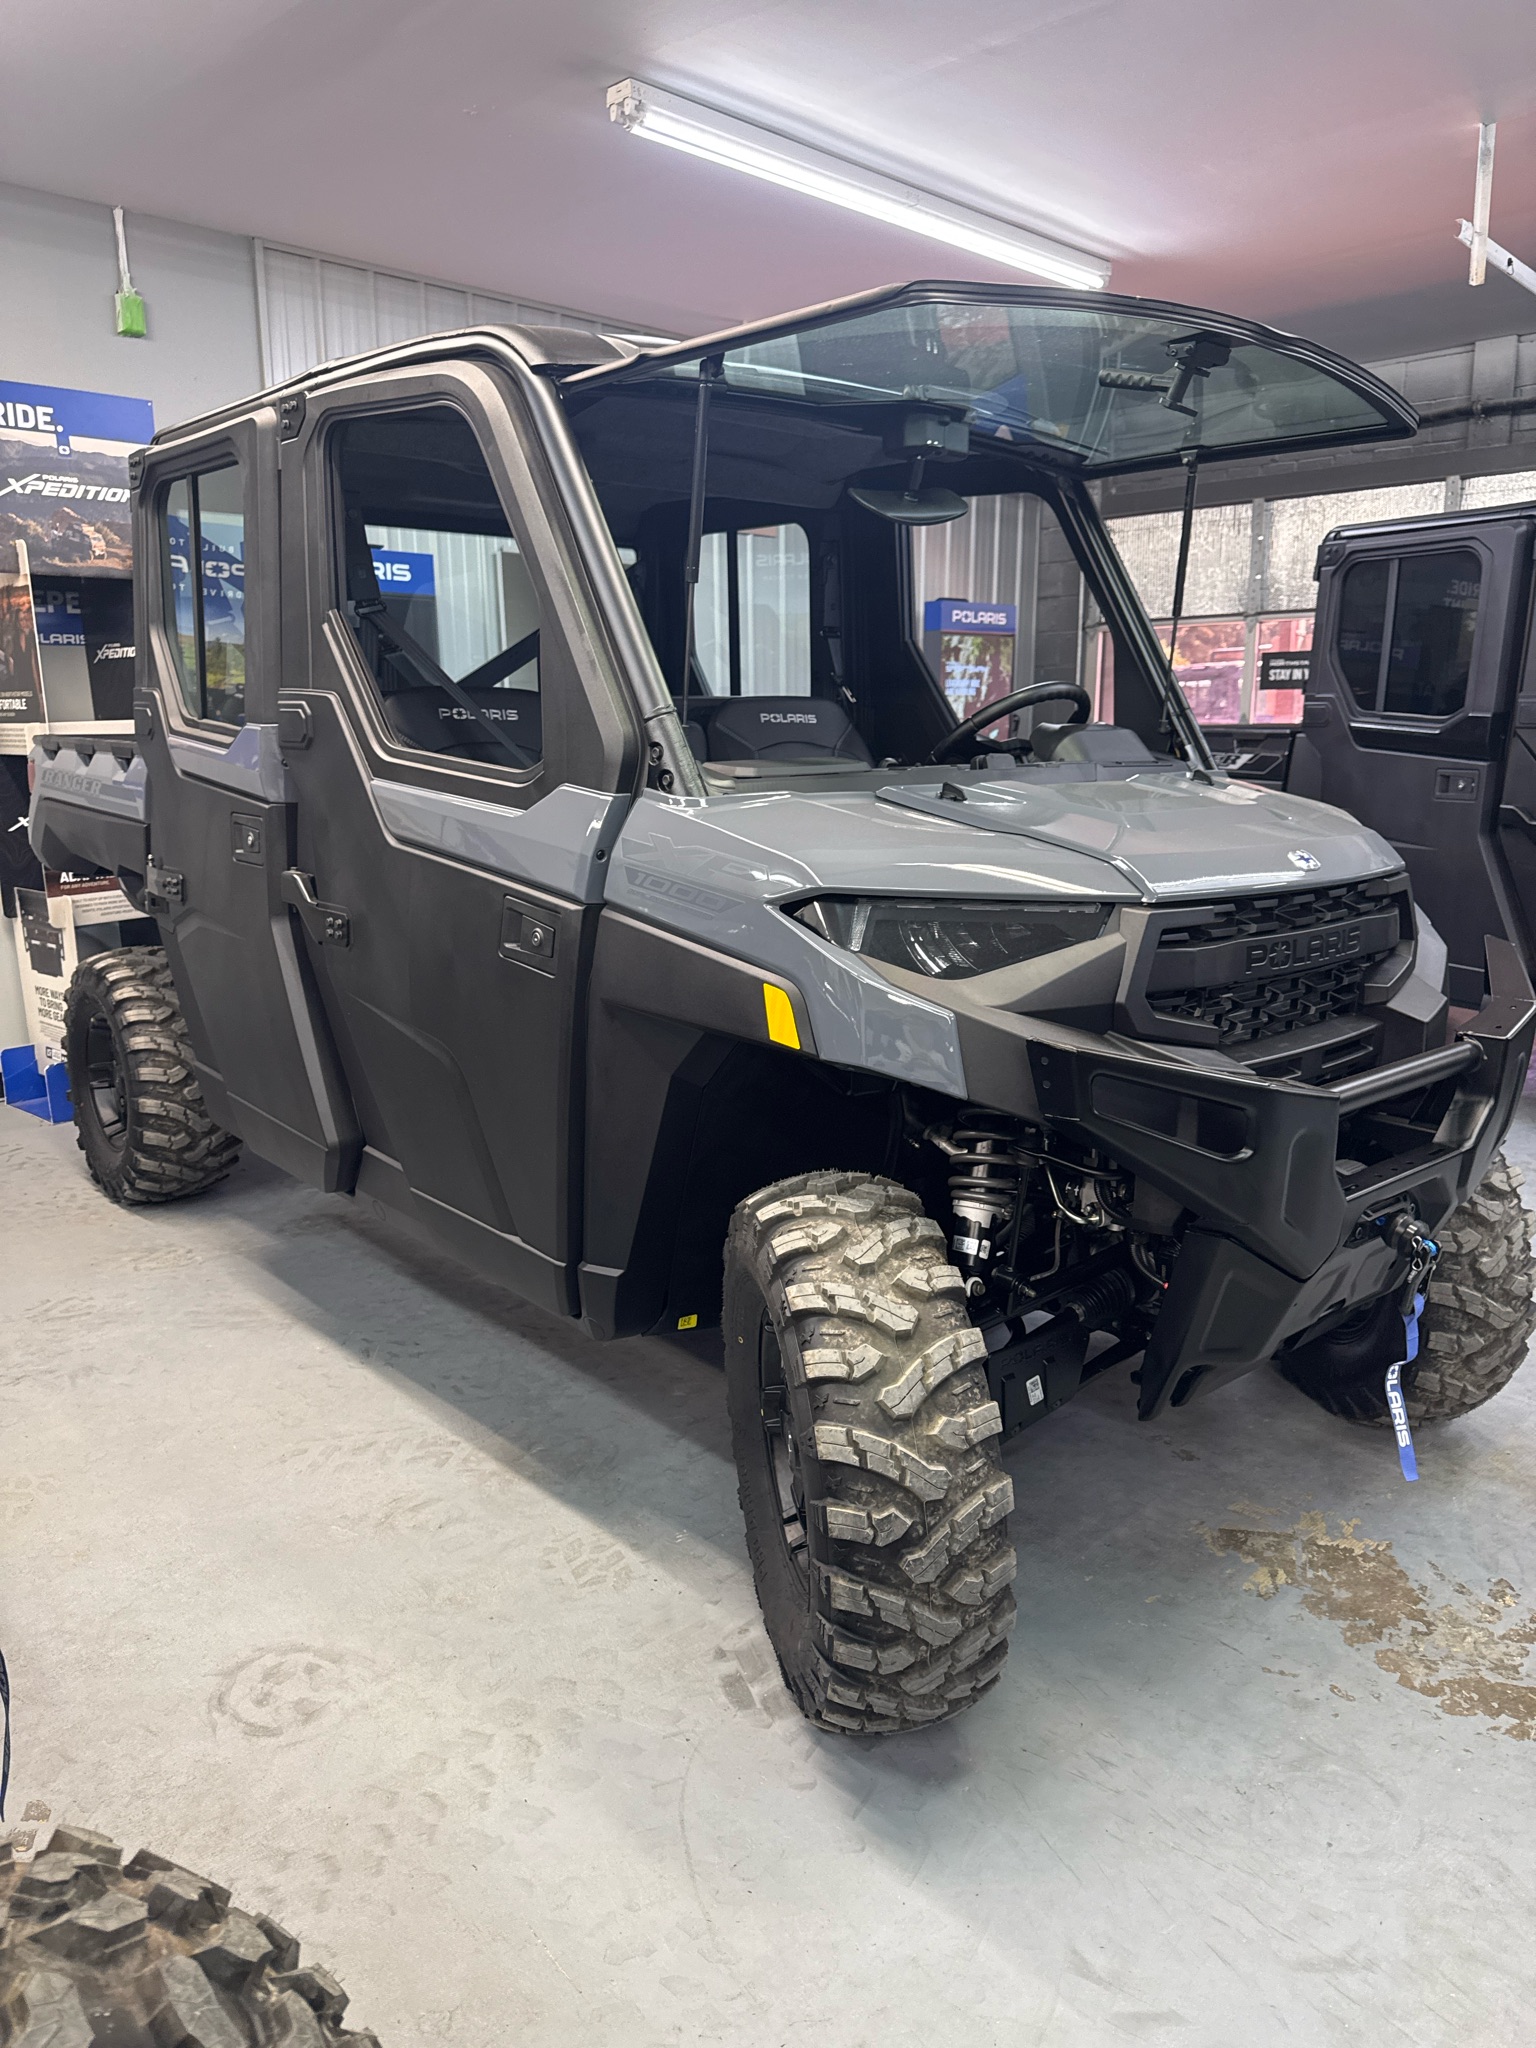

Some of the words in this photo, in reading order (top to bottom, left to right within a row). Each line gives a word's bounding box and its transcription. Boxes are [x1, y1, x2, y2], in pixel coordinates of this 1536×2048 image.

[42, 474, 79, 483] POLARIS
[952, 610, 1007, 626] POLARIS
[760, 713, 818, 724] POLARIS
[45, 769, 102, 796] RANGER
[632, 871, 728, 912] 1000
[1245, 924, 1361, 975] POLARIS
